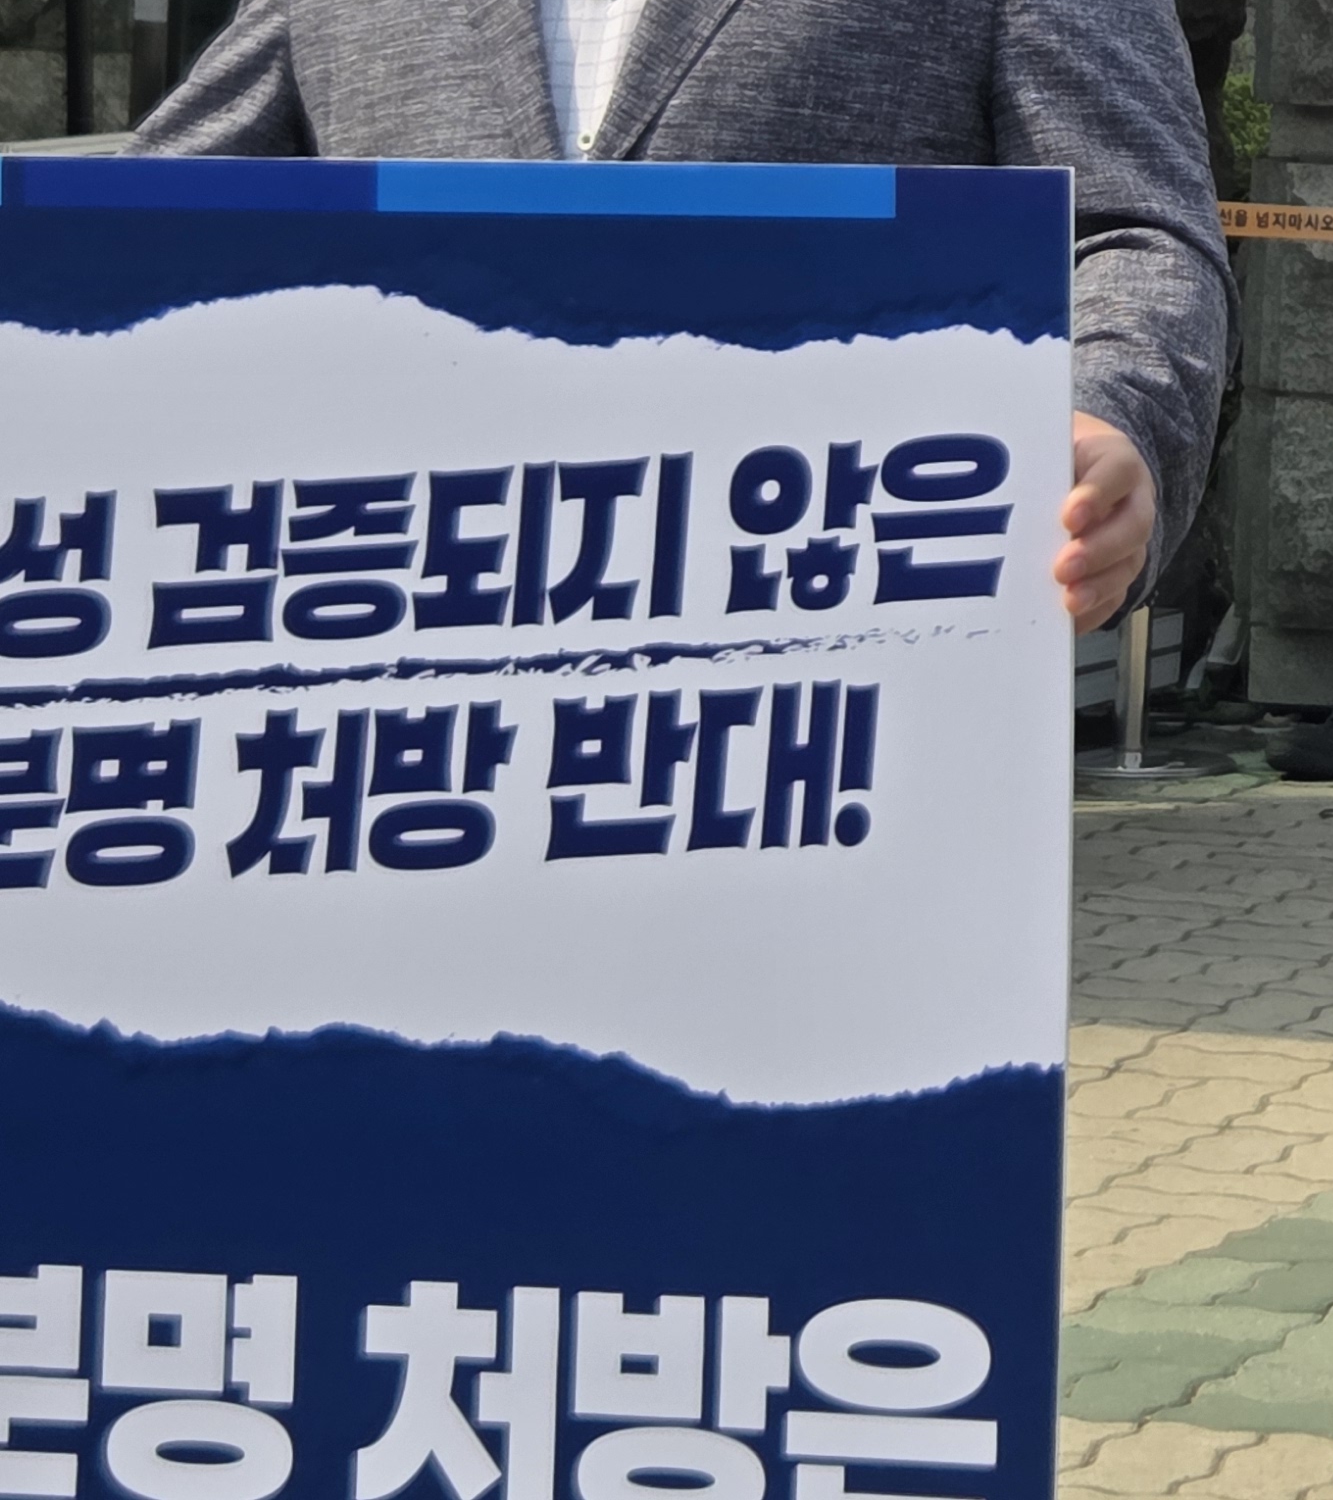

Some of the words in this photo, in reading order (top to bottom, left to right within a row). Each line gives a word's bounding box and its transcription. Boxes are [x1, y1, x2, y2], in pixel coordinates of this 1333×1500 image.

[147, 455, 694, 651] 검증되지
[725, 433, 1014, 615] 않은
[225, 699, 518, 879] 처방
[544, 683, 879, 862] 반대!
[354, 1280, 998, 1500] 처방은
